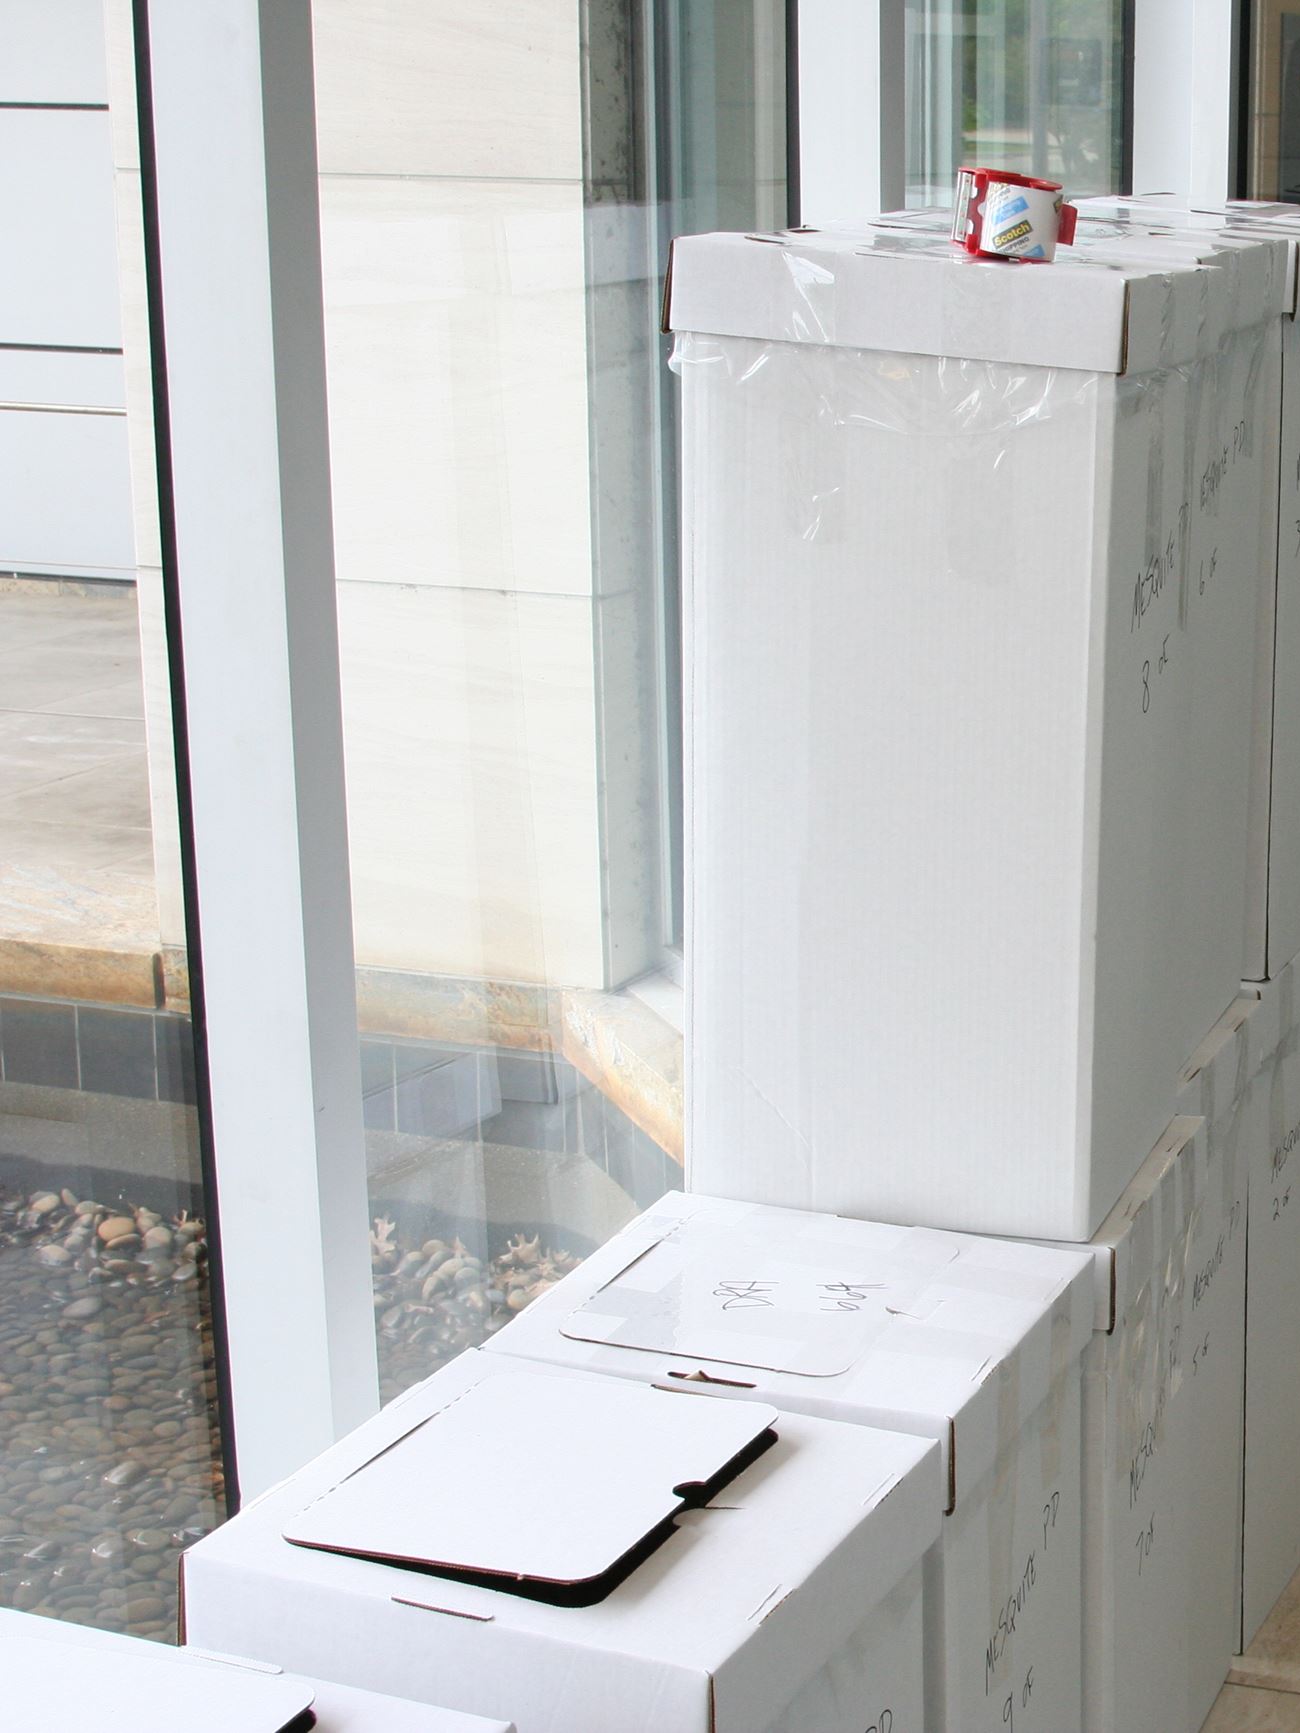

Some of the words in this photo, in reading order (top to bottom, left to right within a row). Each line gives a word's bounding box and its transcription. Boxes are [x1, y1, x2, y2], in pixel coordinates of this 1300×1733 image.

[994, 223, 1030, 246] Scotch
[1232, 420, 1245, 464] PD
[1131, 529, 1175, 632] MESQUITE
[1142, 660, 1150, 714] 8
[985, 1550, 1037, 1697] MESQUITE
[1042, 1490, 1060, 1550] PD
[864, 1708, 893, 1733] D
